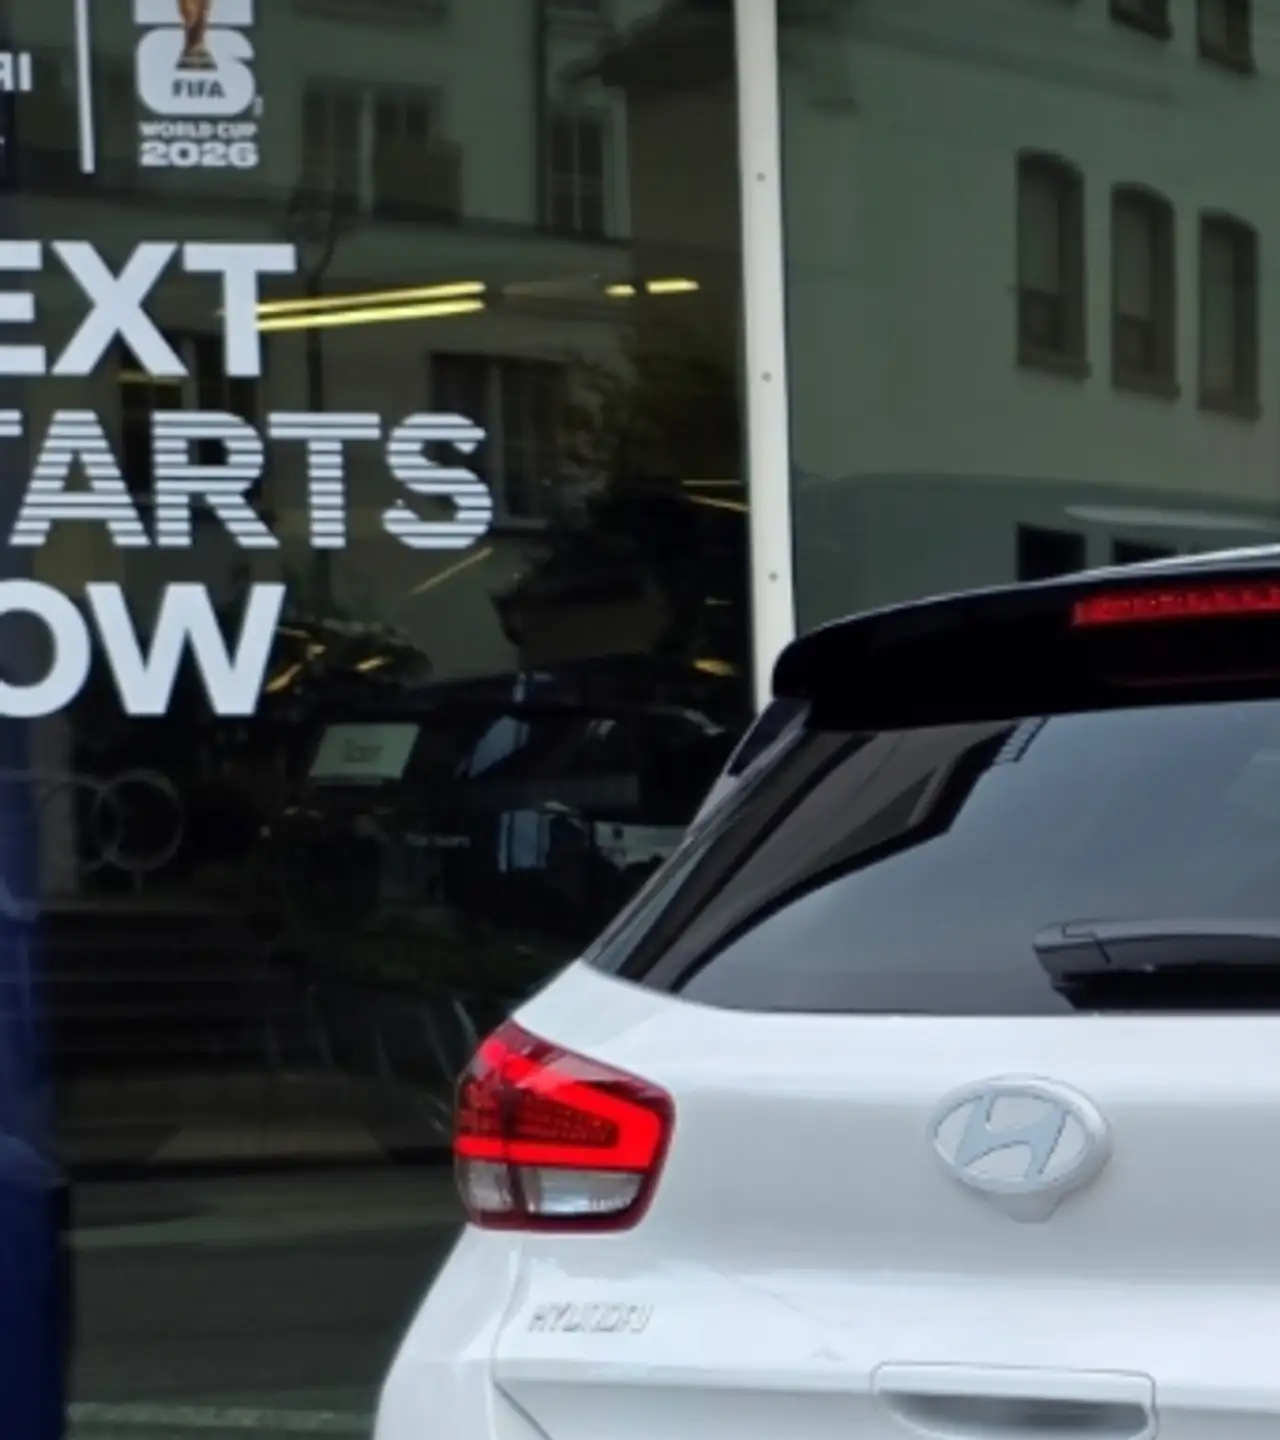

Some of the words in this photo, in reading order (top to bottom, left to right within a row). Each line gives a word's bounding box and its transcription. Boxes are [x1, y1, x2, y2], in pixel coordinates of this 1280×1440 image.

[172, 79, 225, 98] FIFA
[139, 121, 212, 138] WORLD
[217, 121, 257, 138] CUP
[139, 141, 259, 168] 2026
[0, 411, 494, 549] ARTS
